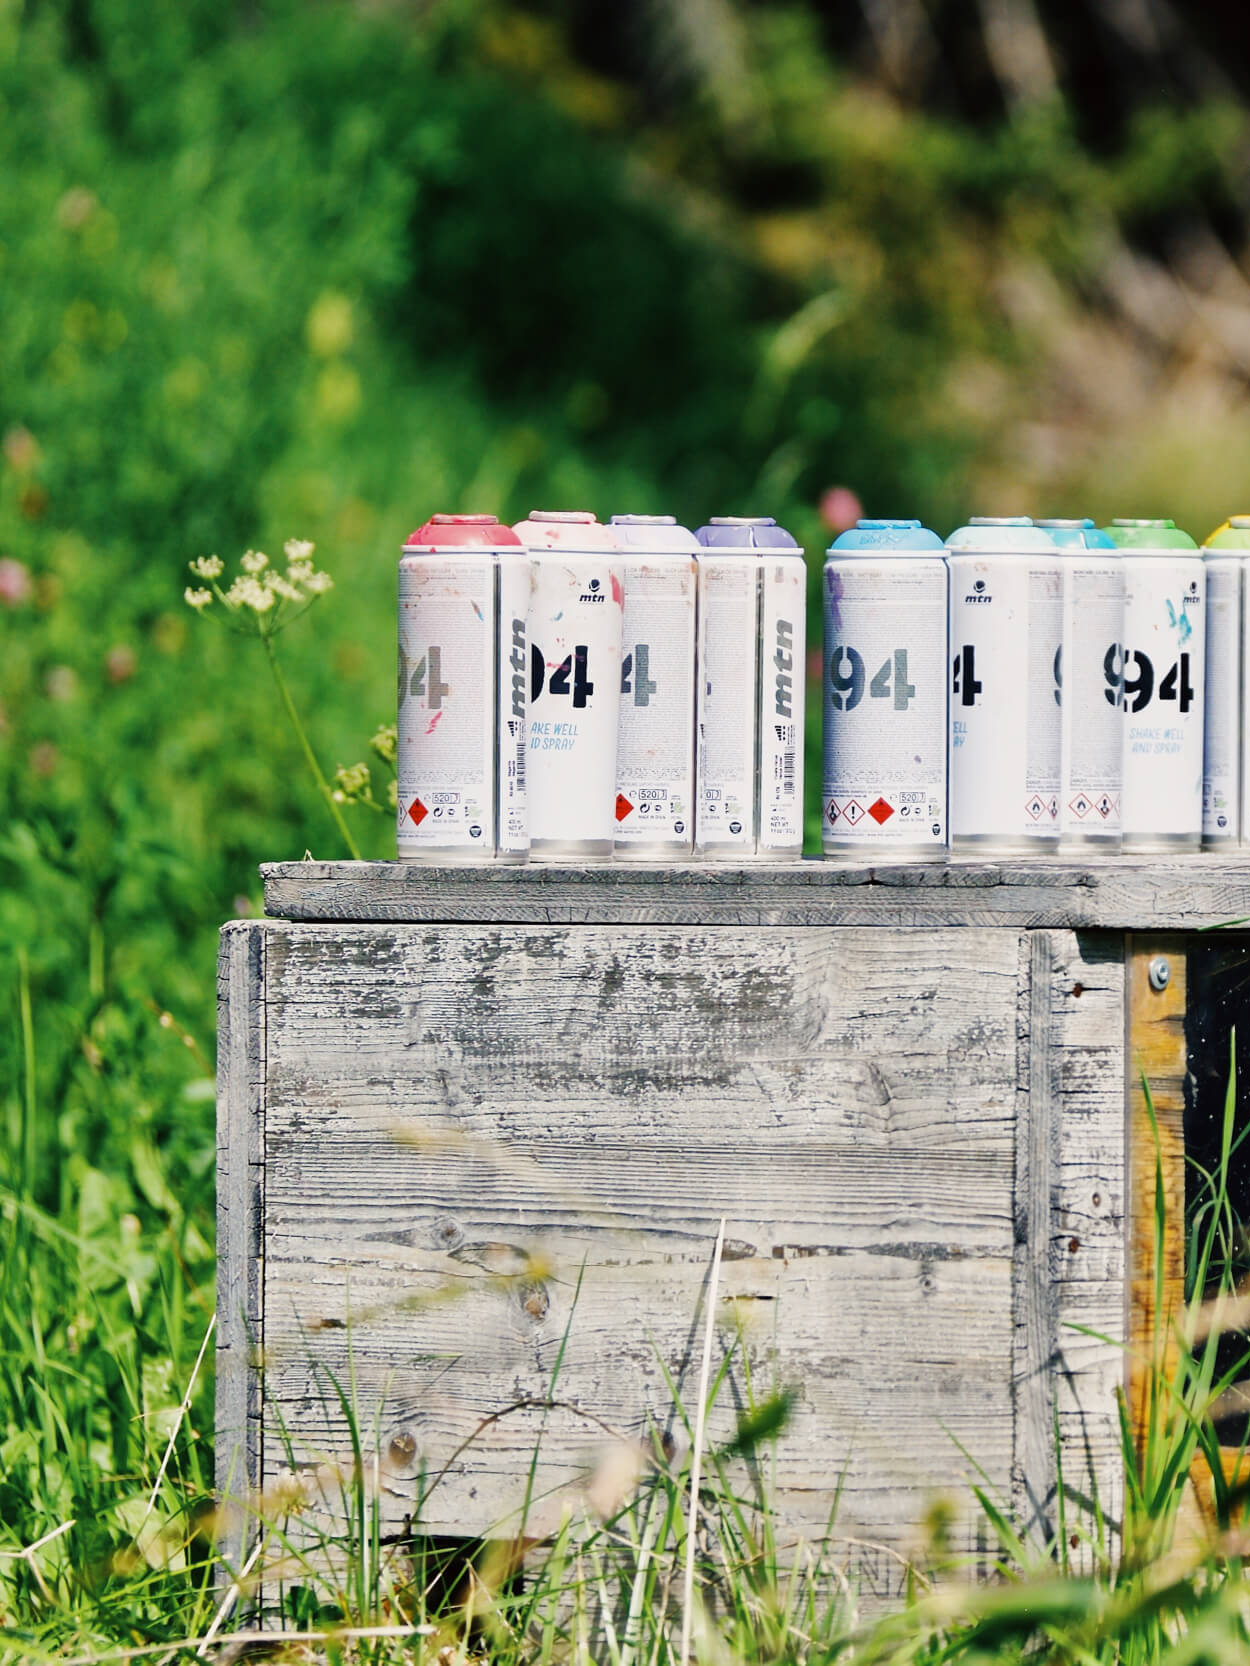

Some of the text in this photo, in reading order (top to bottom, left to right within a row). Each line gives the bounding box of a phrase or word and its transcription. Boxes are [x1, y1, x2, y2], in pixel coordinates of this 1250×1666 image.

[579, 594, 605, 603] mtn
[964, 594, 993, 603] mtn
[773, 619, 794, 719] mtn
[830, 645, 917, 712] 94
[1123, 649, 1194, 714] 94
[553, 723, 579, 736] WELL
[1128, 728, 1185, 740] SHAKE WELL
[542, 737, 576, 751] SPRAY
[1131, 742, 1183, 755] AND SPRAY
